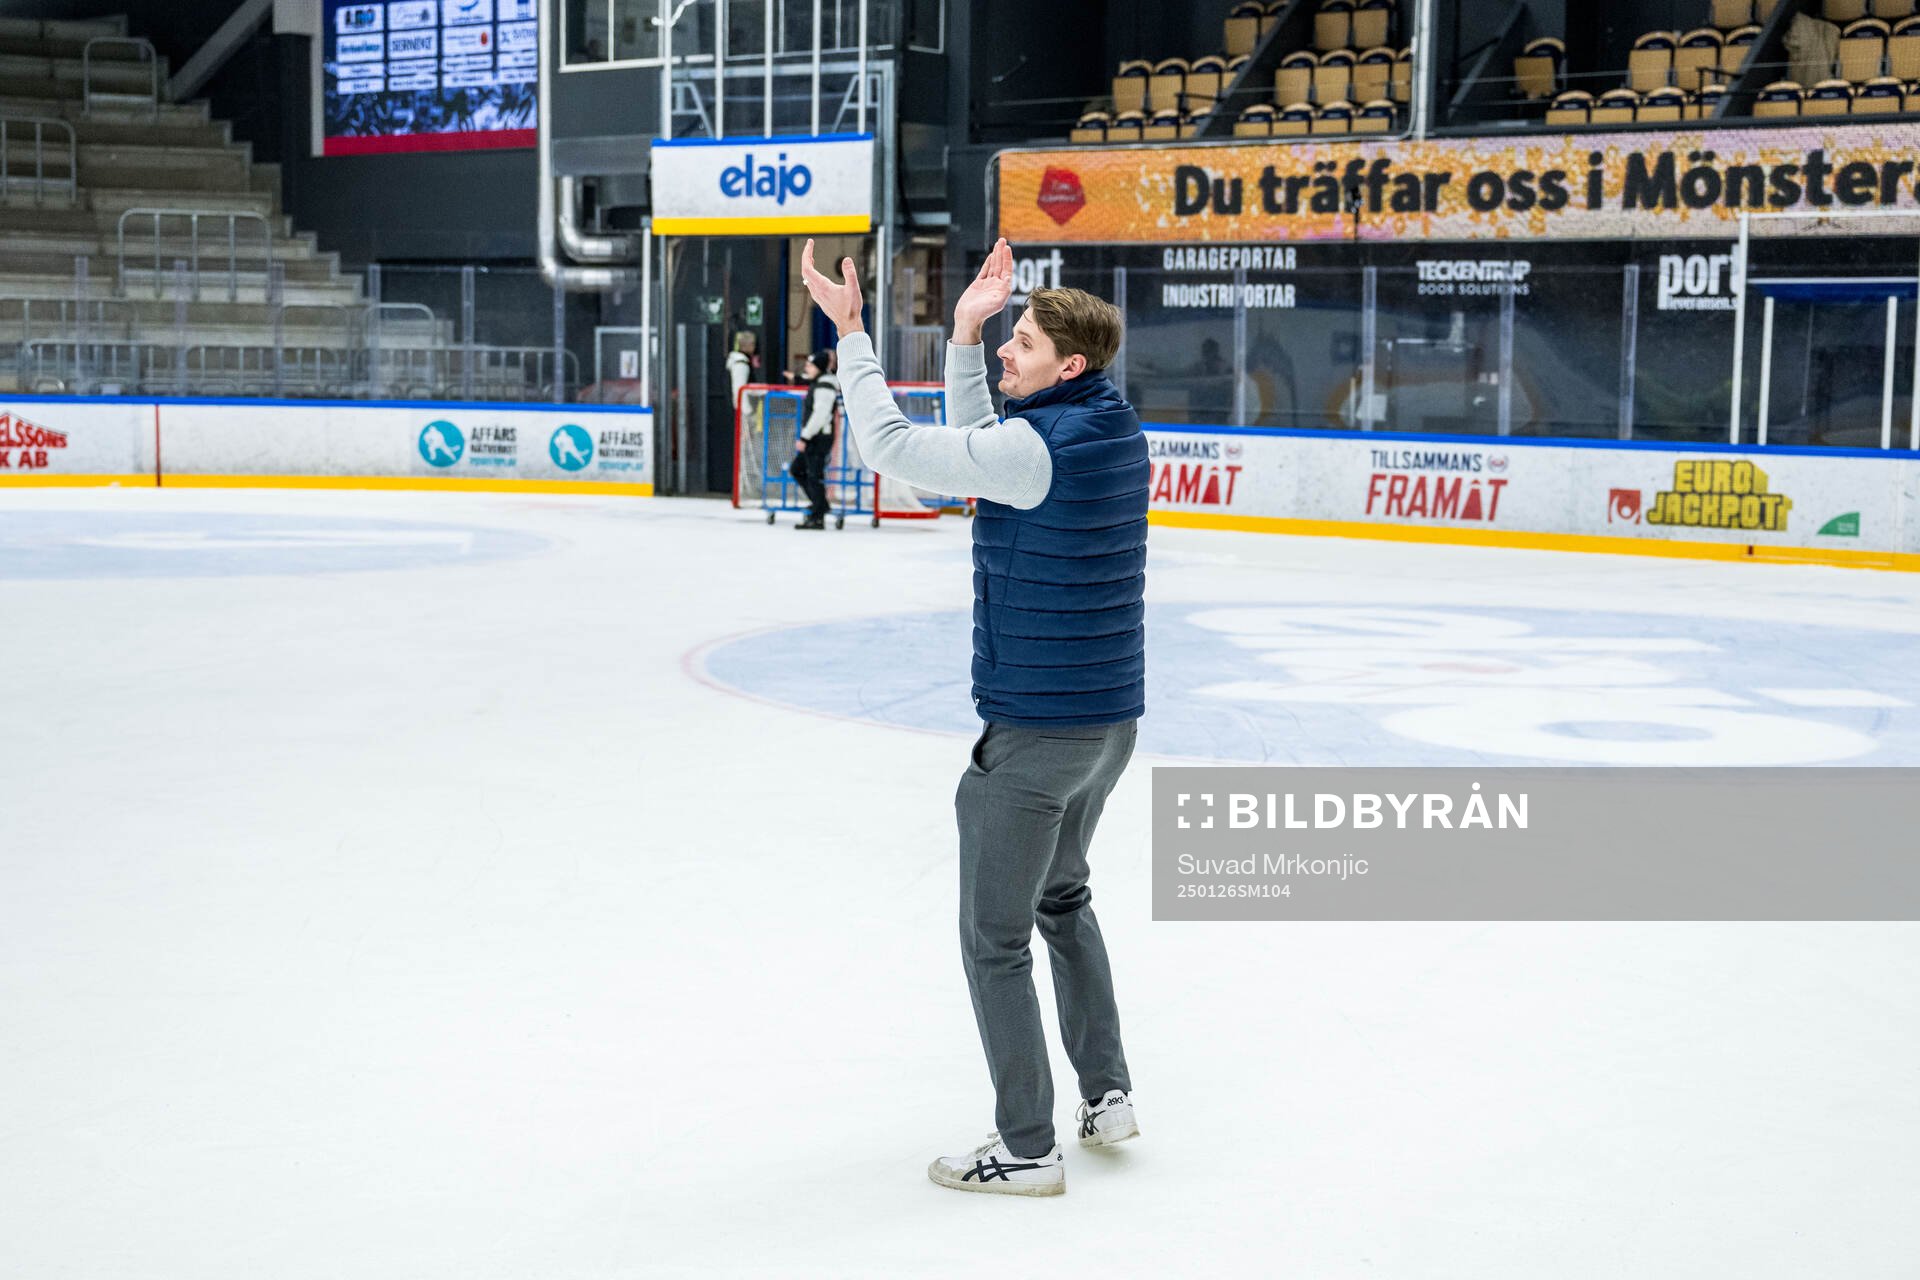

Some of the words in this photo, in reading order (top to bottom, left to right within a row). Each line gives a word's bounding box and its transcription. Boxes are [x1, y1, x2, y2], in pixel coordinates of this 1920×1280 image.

[720, 153, 812, 206] elajo
[1174, 164, 1243, 216] Du
[1259, 157, 1452, 215] träffar
[1466, 169, 1568, 212] oss
[1586, 150, 1603, 210] i
[1011, 248, 1064, 293] ort
[1163, 246, 1297, 271] GARAGEPORTAR
[1162, 284, 1296, 308] INDUSTRIPORTAR
[1417, 283, 1454, 295] DOOR
[18, 451, 49, 469] AB
[1370, 449, 1483, 473] TILLSAMMANS
[1674, 460, 1755, 494] EURO
[1149, 463, 1243, 506] AMÅT
[1646, 491, 1786, 530] JACKPOT
